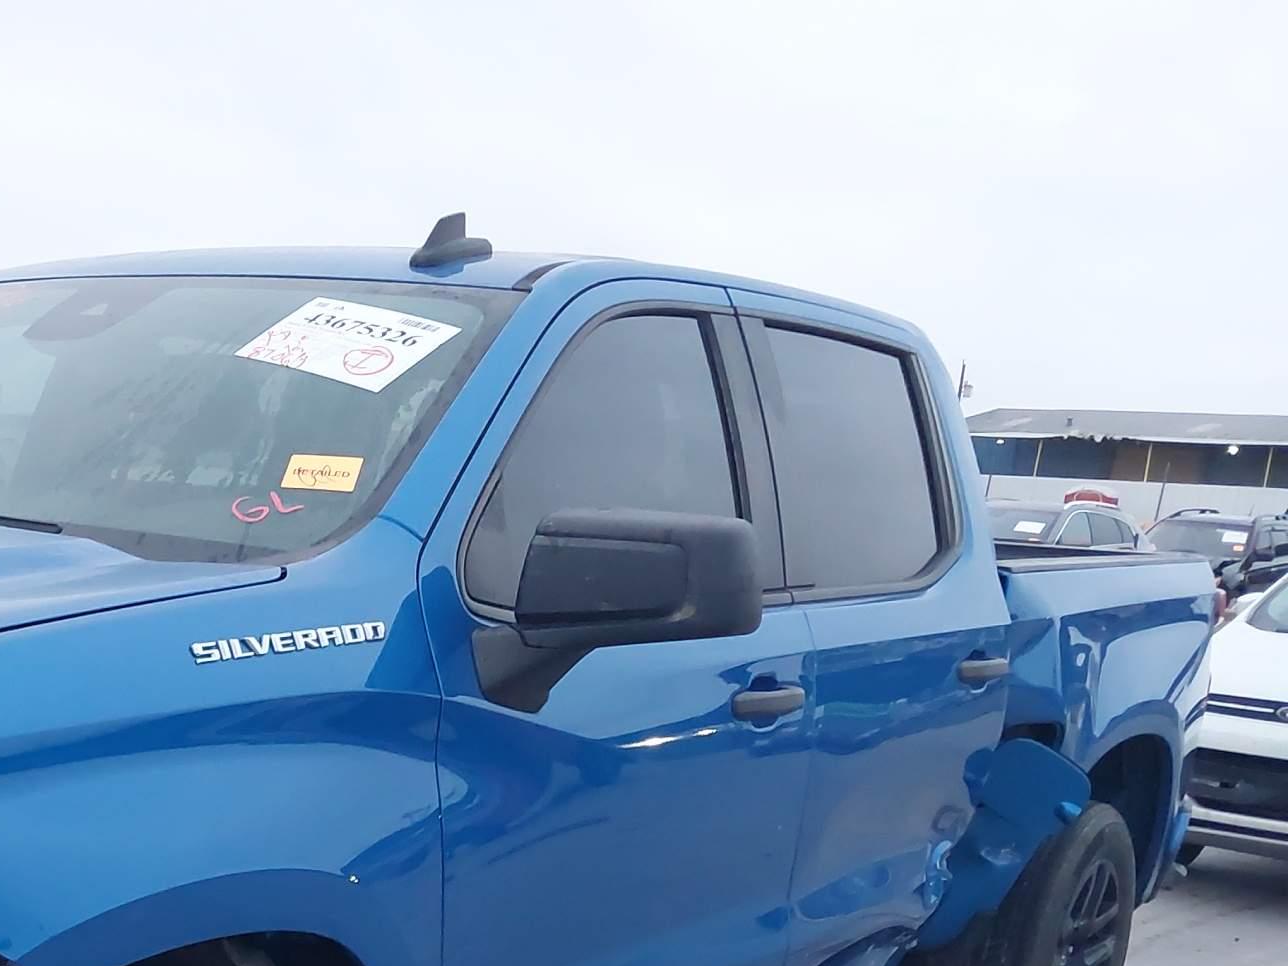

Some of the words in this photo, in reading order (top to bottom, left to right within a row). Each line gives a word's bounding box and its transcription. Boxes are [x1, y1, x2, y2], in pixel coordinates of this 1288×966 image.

[304, 313, 423, 346] 43675326
[231, 491, 304, 523] GL
[191, 621, 386, 665] SILVERADO
